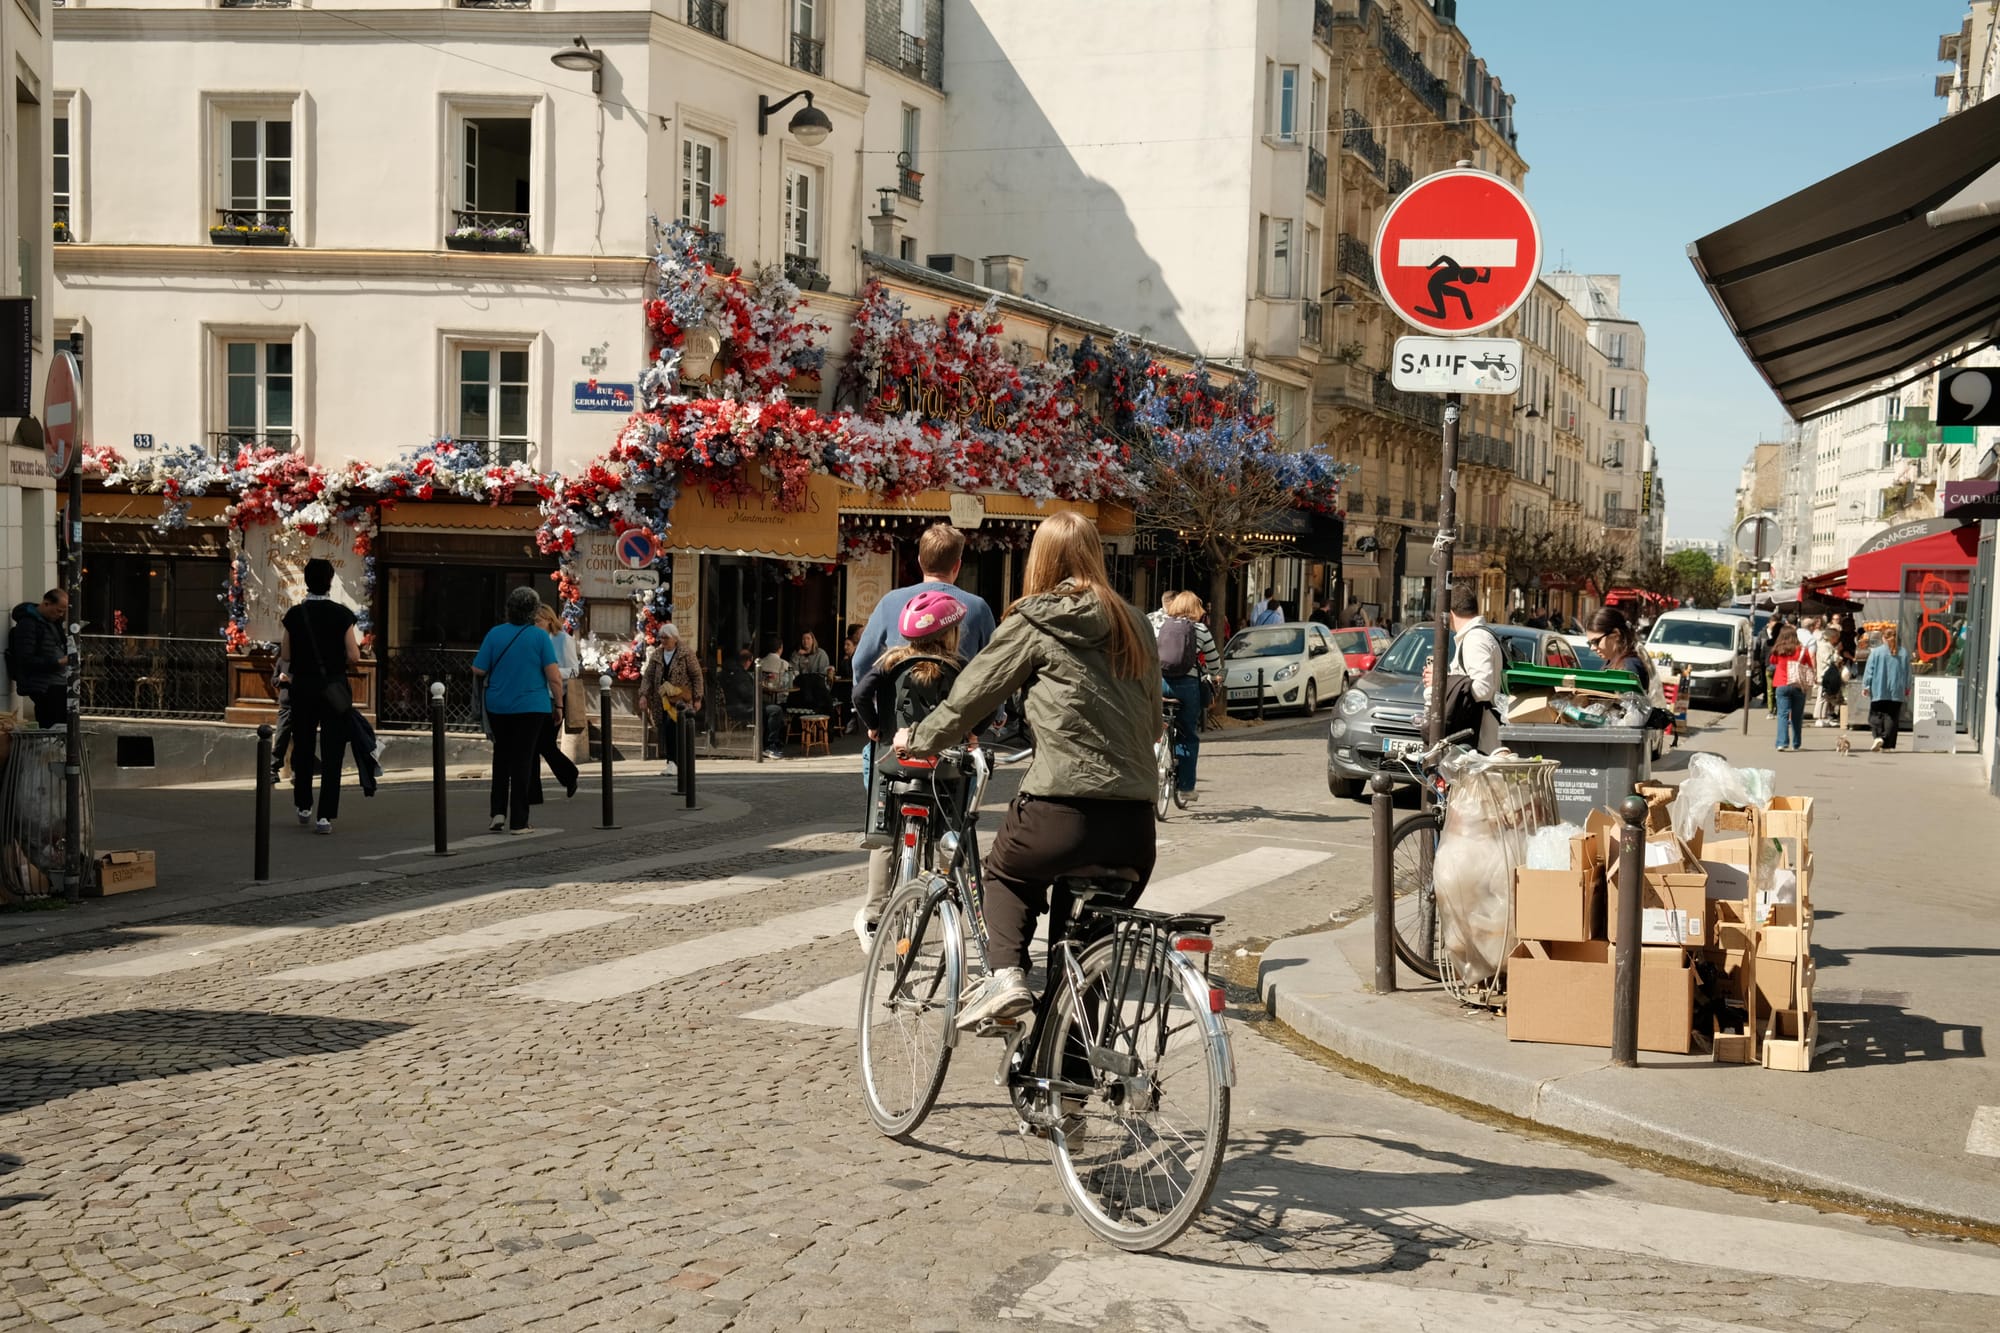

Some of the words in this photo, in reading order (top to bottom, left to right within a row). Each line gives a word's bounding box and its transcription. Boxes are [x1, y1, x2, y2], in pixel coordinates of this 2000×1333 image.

[1400, 353, 1467, 375] SAUF
[597, 387, 613, 395] RUE
[575, 398, 609, 406] GERMAIN
[611, 399, 634, 407] PILON
[135, 435, 151, 448] 33
[1643, 471, 1652, 508] HOTEL
[728, 511, 786, 525] Montmartre
[1135, 533, 1159, 551] RRE
[591, 544, 617, 556] SERV
